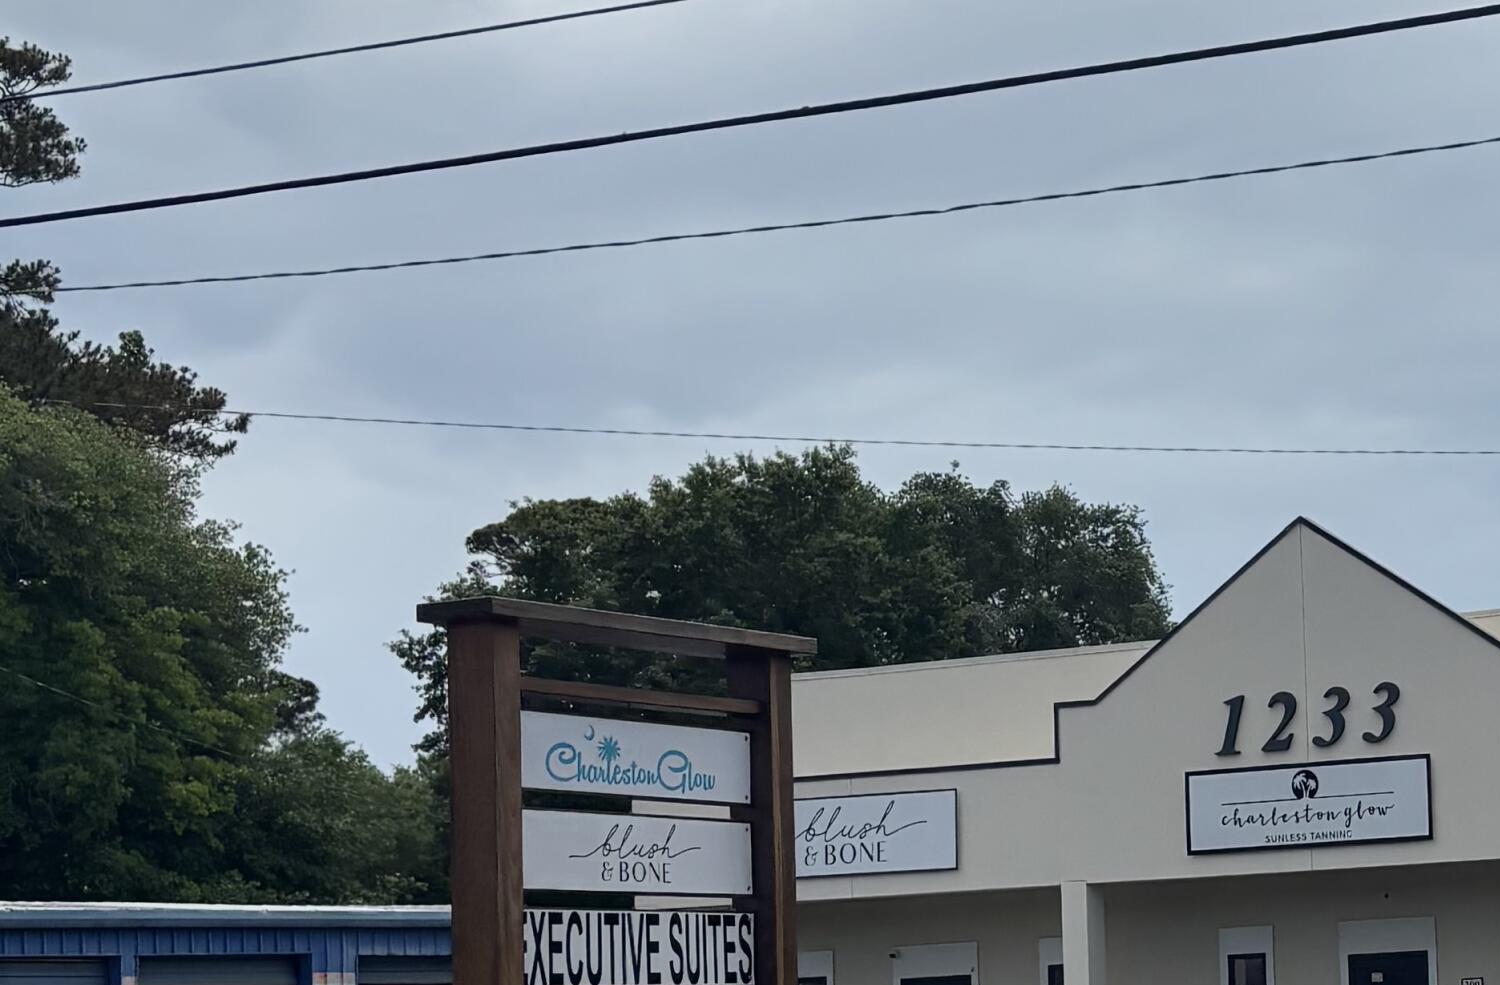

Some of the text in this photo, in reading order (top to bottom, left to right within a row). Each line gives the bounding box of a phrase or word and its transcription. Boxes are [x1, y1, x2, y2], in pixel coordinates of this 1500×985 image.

[1214, 681, 1400, 757] 1233
[795, 800, 927, 843] blush
[1265, 829, 1352, 843] SUNLESS TANNING
[569, 824, 701, 859] blush
[804, 841, 887, 866] & BONE
[601, 861, 671, 884] & BONE
[669, 912, 754, 985] SUITES
